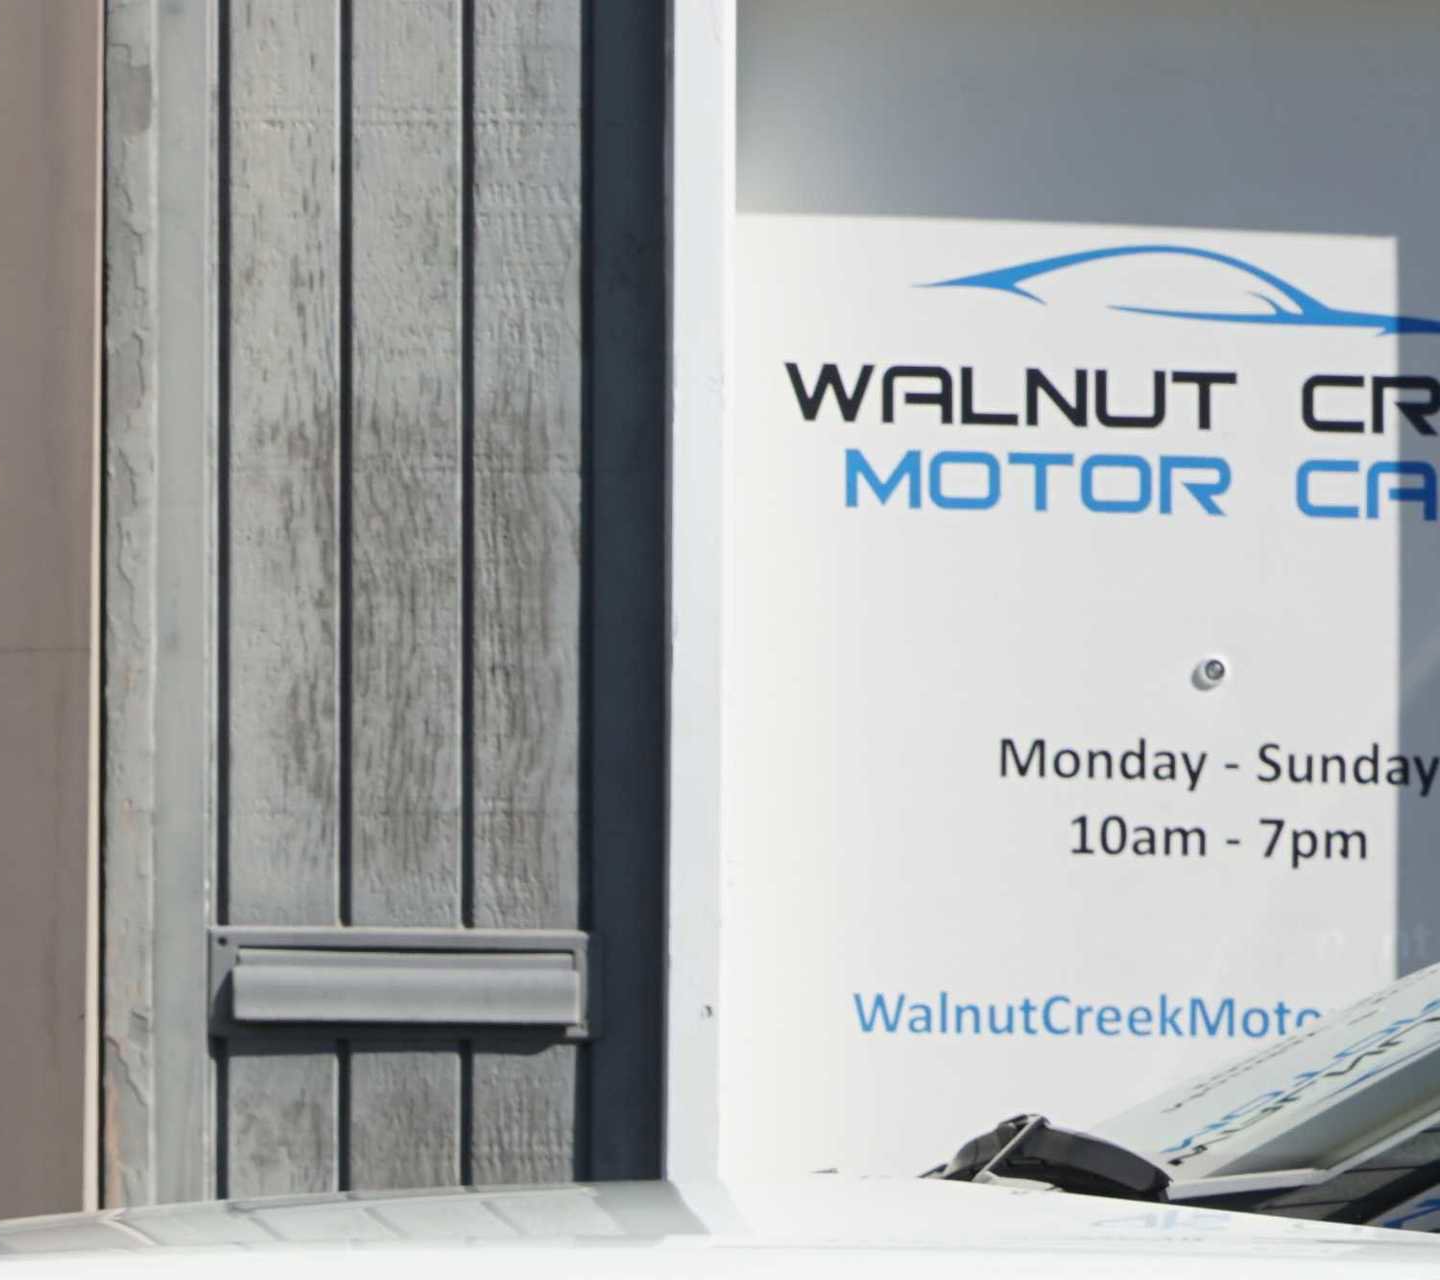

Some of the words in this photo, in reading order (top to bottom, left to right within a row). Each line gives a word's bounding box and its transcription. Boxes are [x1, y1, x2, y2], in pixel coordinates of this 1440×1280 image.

[784, 361, 1238, 430] WALNUT
[844, 449, 1232, 516] MOTOR
[1000, 737, 1209, 793] Monday
[1222, 762, 1240, 771] -
[1071, 813, 1208, 858] 10am
[1224, 837, 1241, 846] -
[1258, 817, 1369, 870] 7pm
